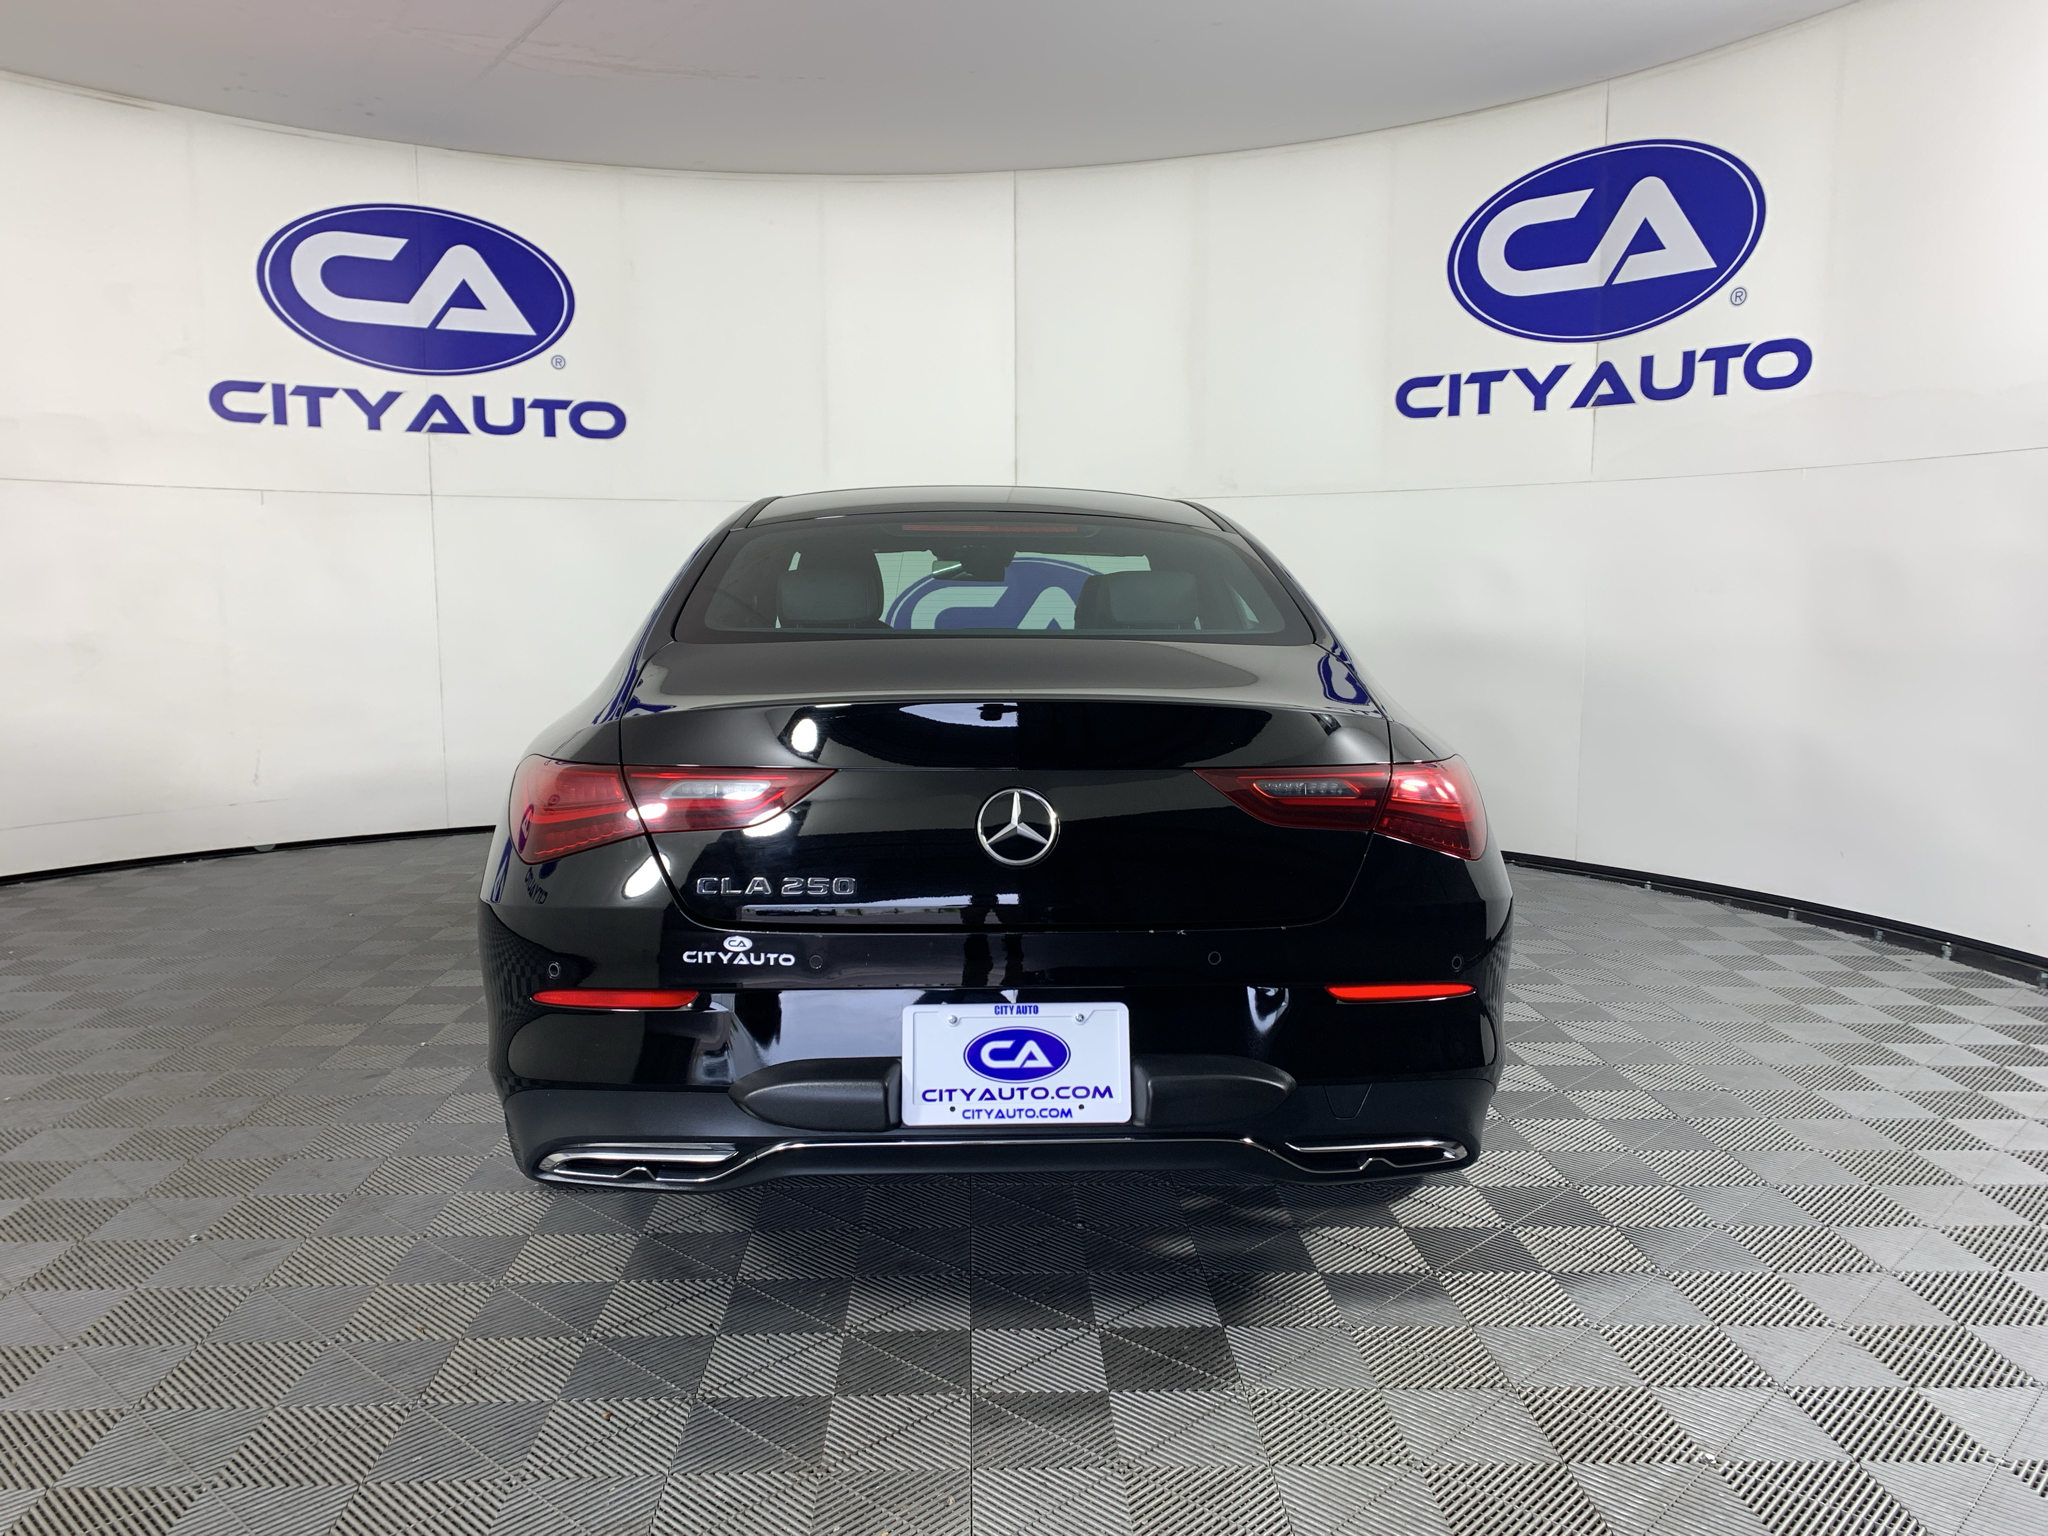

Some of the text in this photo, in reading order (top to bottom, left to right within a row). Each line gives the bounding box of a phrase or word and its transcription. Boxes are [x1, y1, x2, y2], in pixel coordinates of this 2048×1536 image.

[1477, 176, 1718, 297] CA
[290, 231, 537, 336] CA
[696, 877, 856, 895] CLA 250
[994, 1005, 1039, 1015] CITY AUTO
[980, 1040, 1054, 1068] CA
[921, 1085, 1114, 1102] CITYAUTO.COM
[962, 1107, 1073, 1119] CITYAUTO.COM
